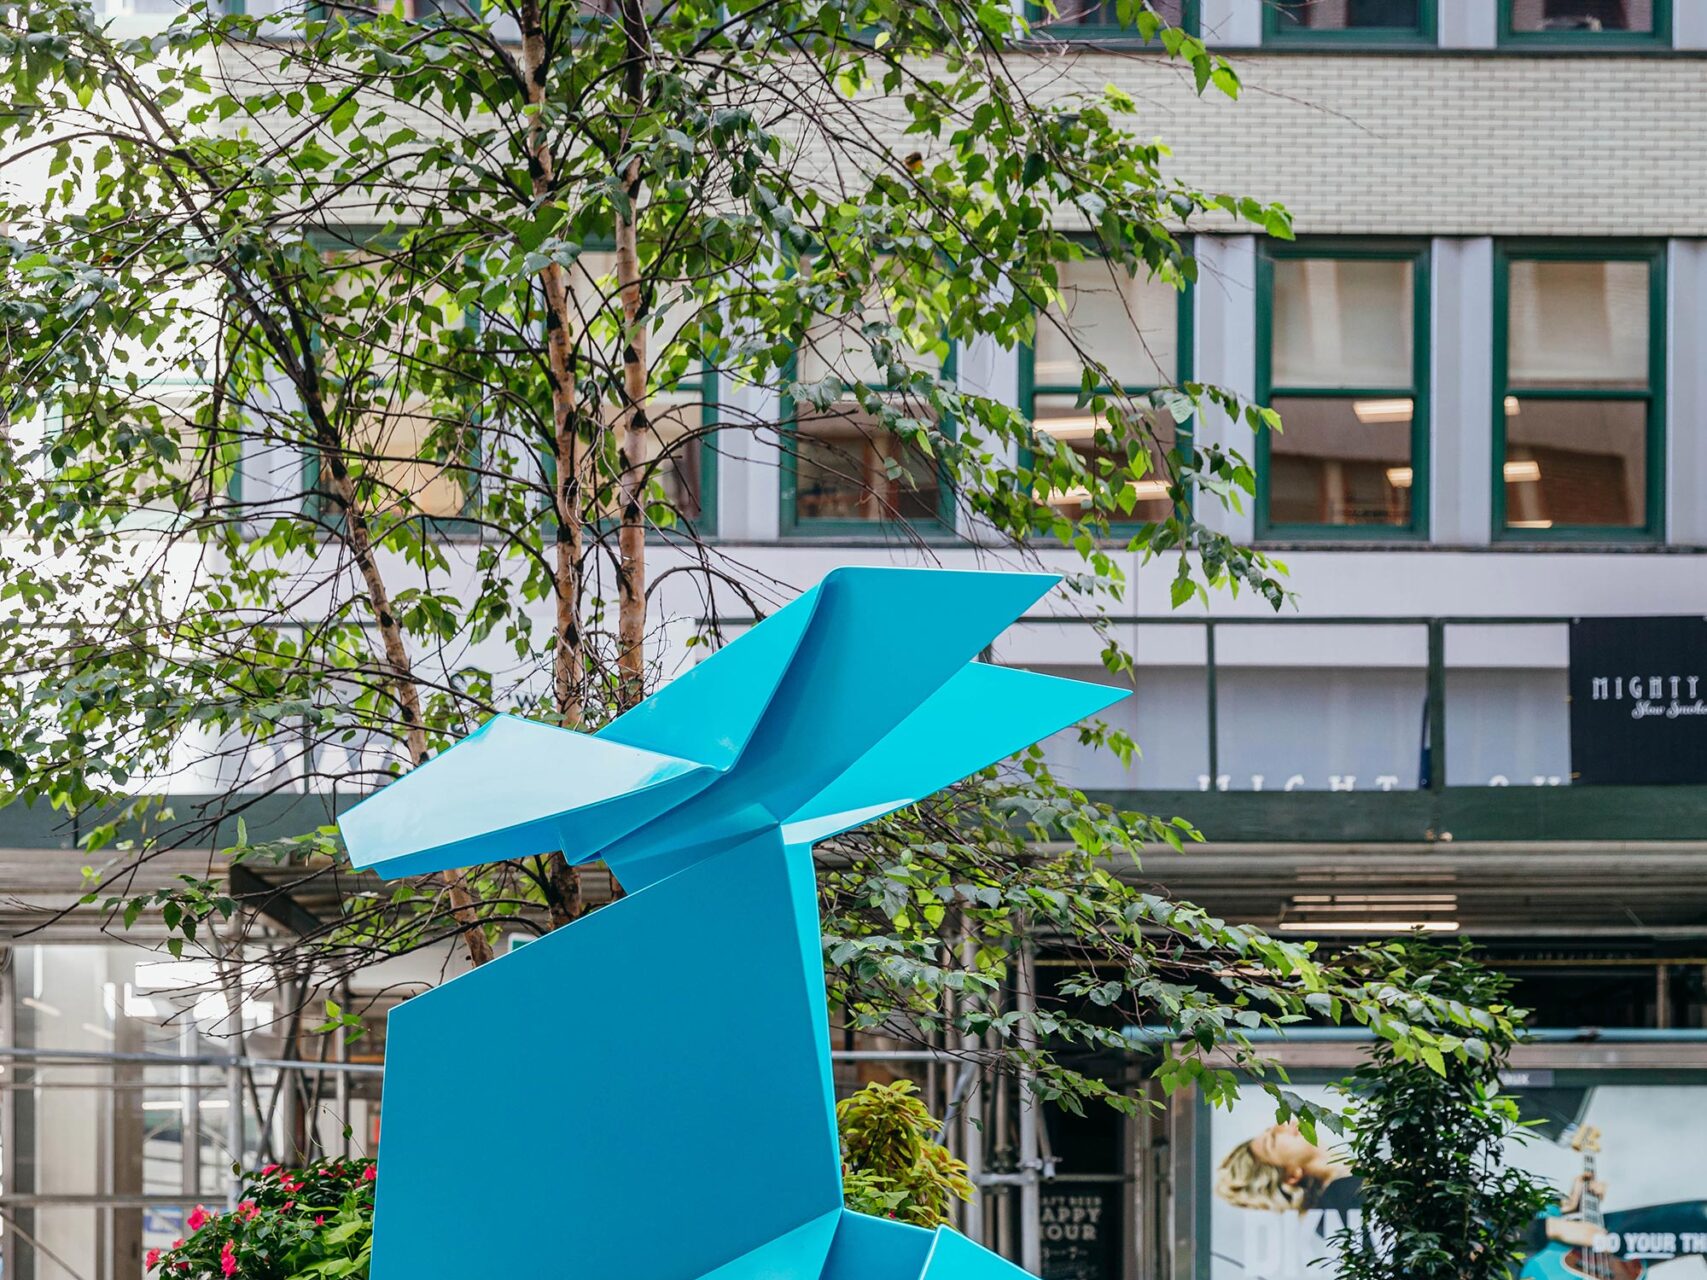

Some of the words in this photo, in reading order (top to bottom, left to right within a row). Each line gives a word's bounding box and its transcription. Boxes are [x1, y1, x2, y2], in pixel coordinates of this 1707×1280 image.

[1592, 676, 1700, 700] MIGHTY
[1041, 1207, 1101, 1222] APPY
[1623, 1232, 1677, 1253] YOUR
